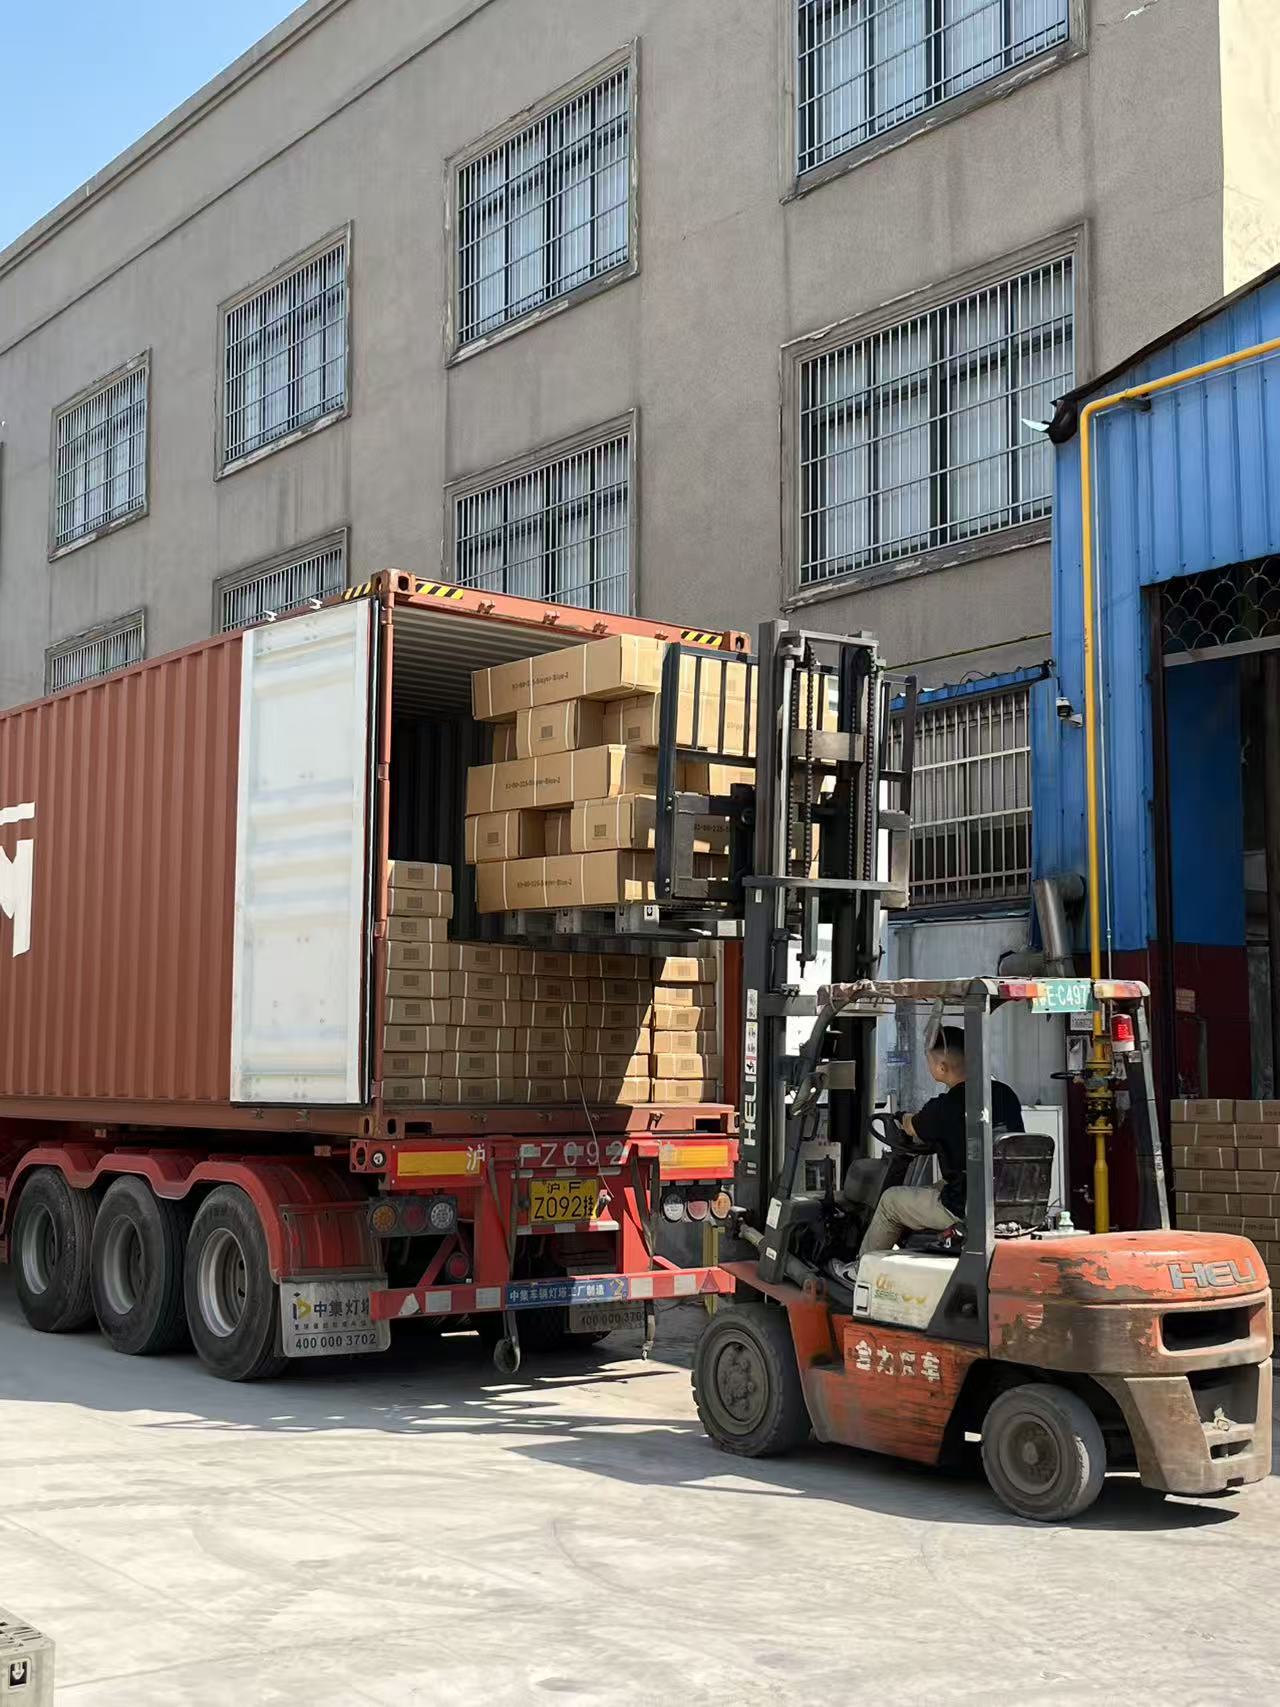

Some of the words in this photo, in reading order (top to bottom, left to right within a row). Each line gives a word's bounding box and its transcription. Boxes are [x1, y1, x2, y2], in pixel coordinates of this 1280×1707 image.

[1032, 984, 1090, 1006] E·C497
[744, 1075, 757, 1146] HELI
[534, 1195, 595, 1219] Z092挂
[623, 1311, 644, 1322] 370
[296, 1337, 317, 1350] 400
[321, 1335, 342, 1348] 000
[346, 1333, 377, 1346] 3702
